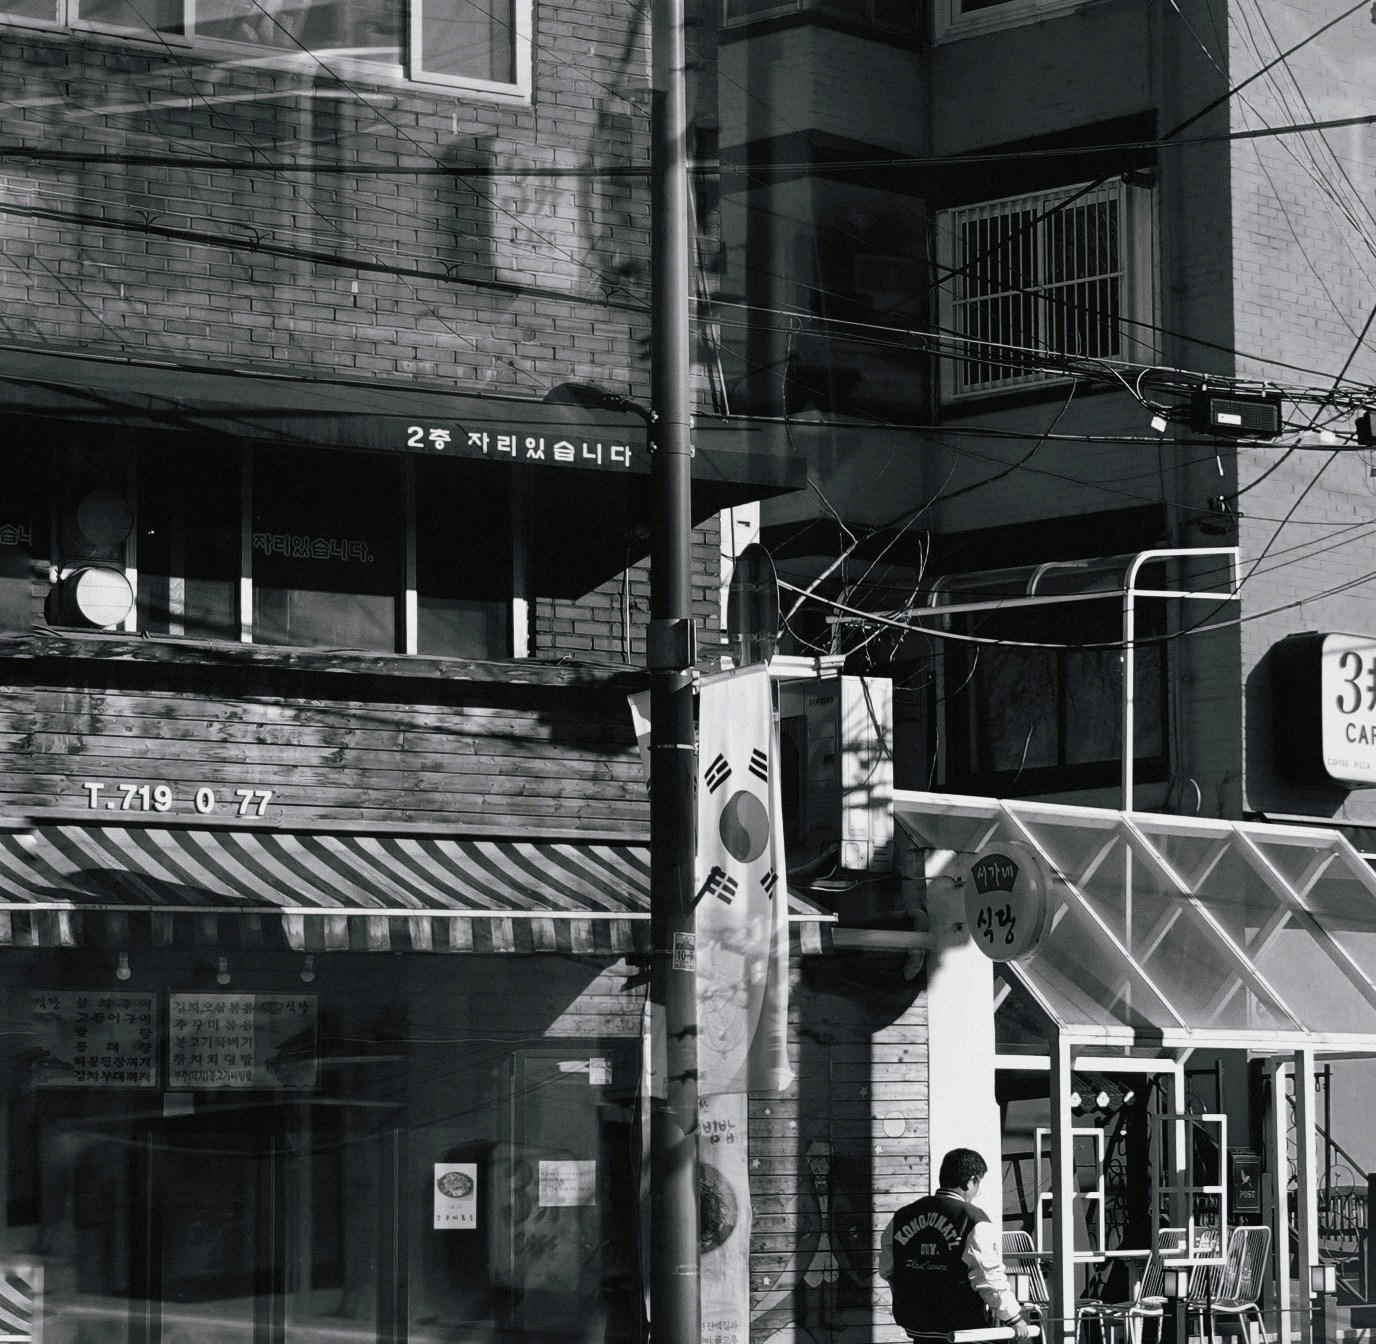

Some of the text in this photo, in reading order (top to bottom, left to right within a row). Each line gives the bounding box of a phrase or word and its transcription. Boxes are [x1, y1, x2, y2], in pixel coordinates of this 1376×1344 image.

[407, 426, 632, 467] 2층 자리있습니다
[82, 782, 173, 812] T.719
[976, 862, 1014, 888] 서가네
[977, 904, 1016, 944] 식당
